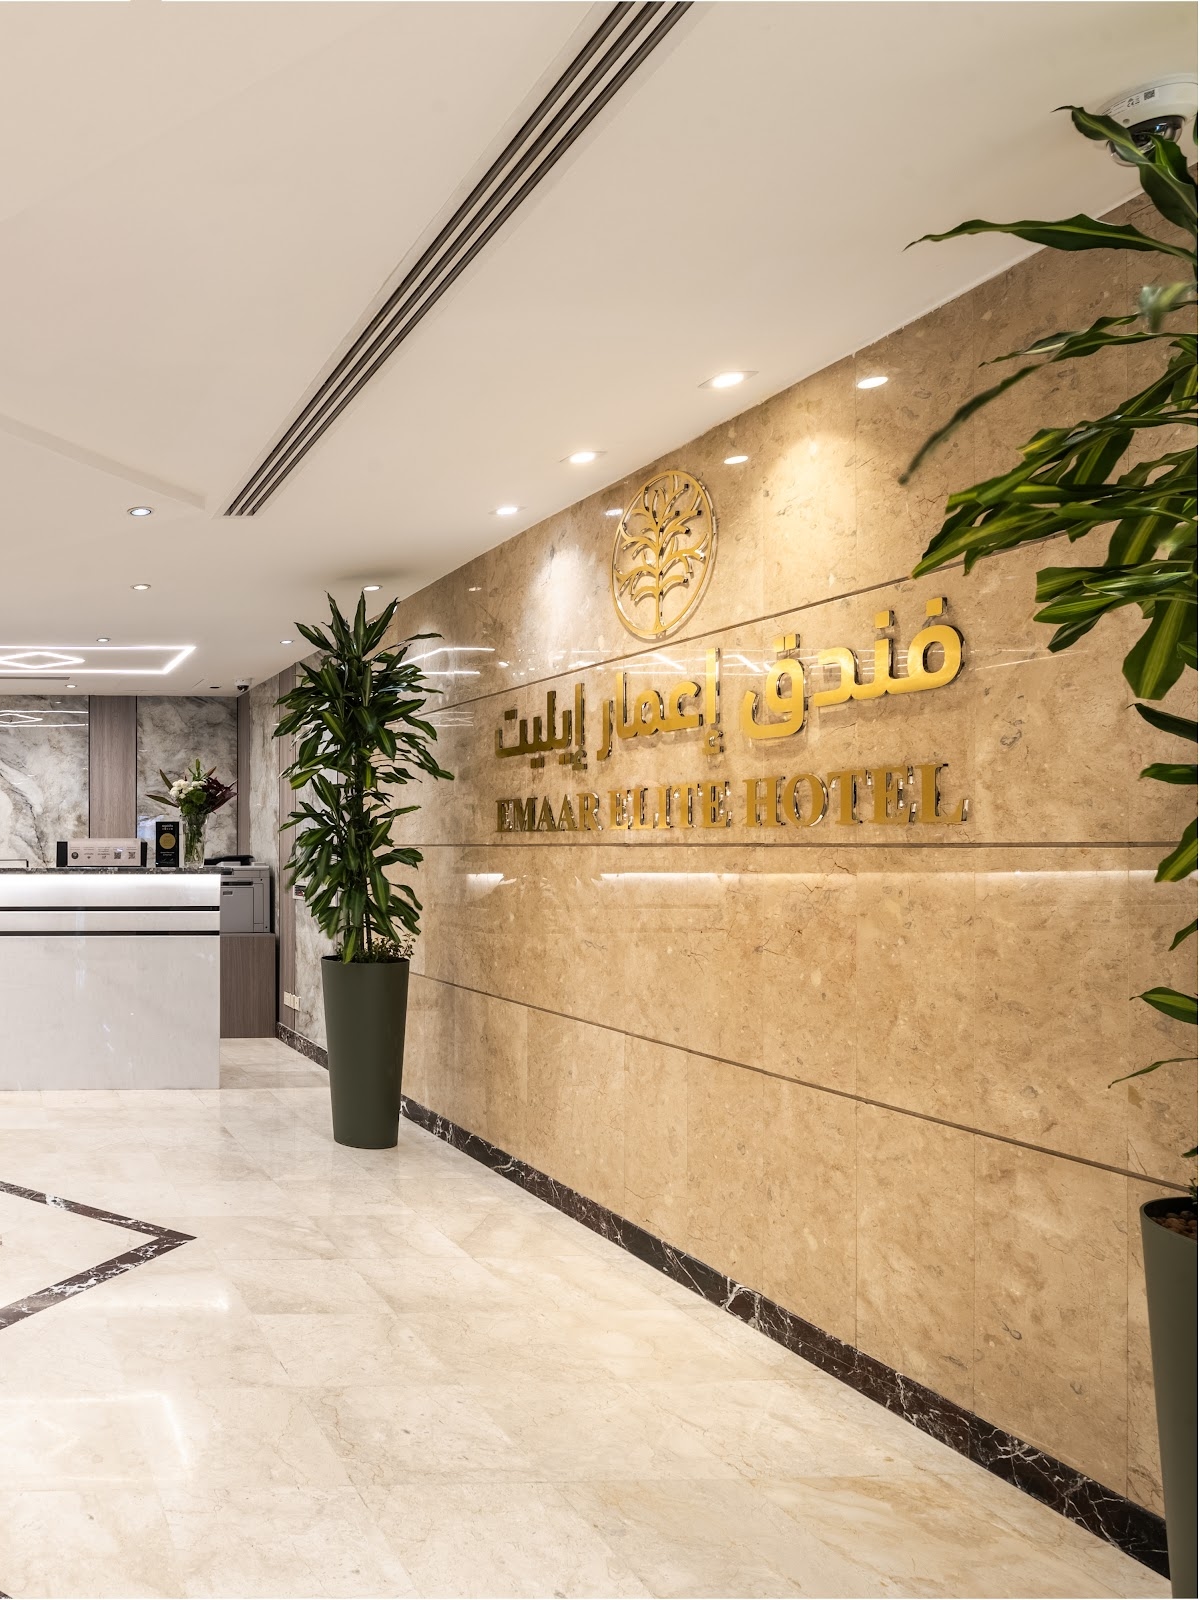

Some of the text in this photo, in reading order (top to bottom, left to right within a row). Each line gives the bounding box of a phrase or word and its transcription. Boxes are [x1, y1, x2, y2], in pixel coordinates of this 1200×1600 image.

[494, 597, 964, 770] فندق إعمار إيليت
[496, 763, 971, 832] EMAAR ELITE HOTEL
